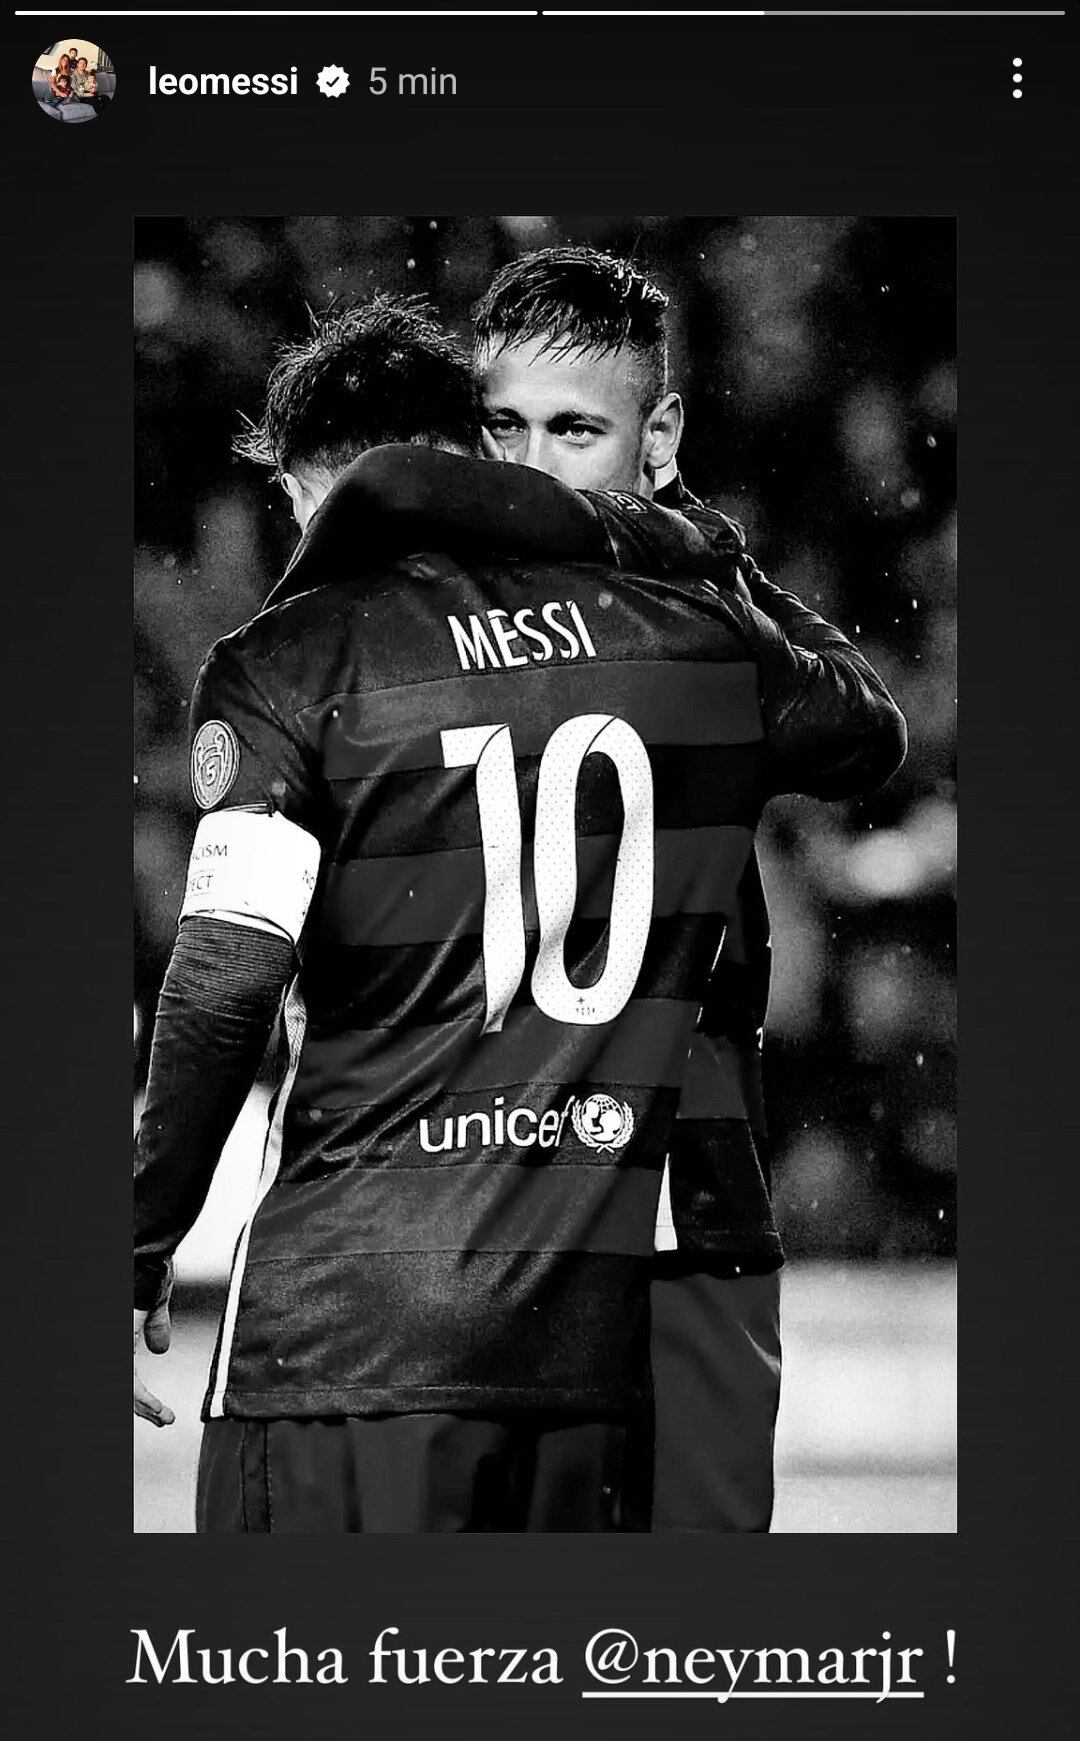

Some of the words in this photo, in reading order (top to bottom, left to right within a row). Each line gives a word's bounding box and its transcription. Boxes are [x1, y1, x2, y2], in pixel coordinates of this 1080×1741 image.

[447, 600, 597, 670] MESSI
[440, 713, 654, 1034] 10
[419, 1095, 576, 1154] unicef
